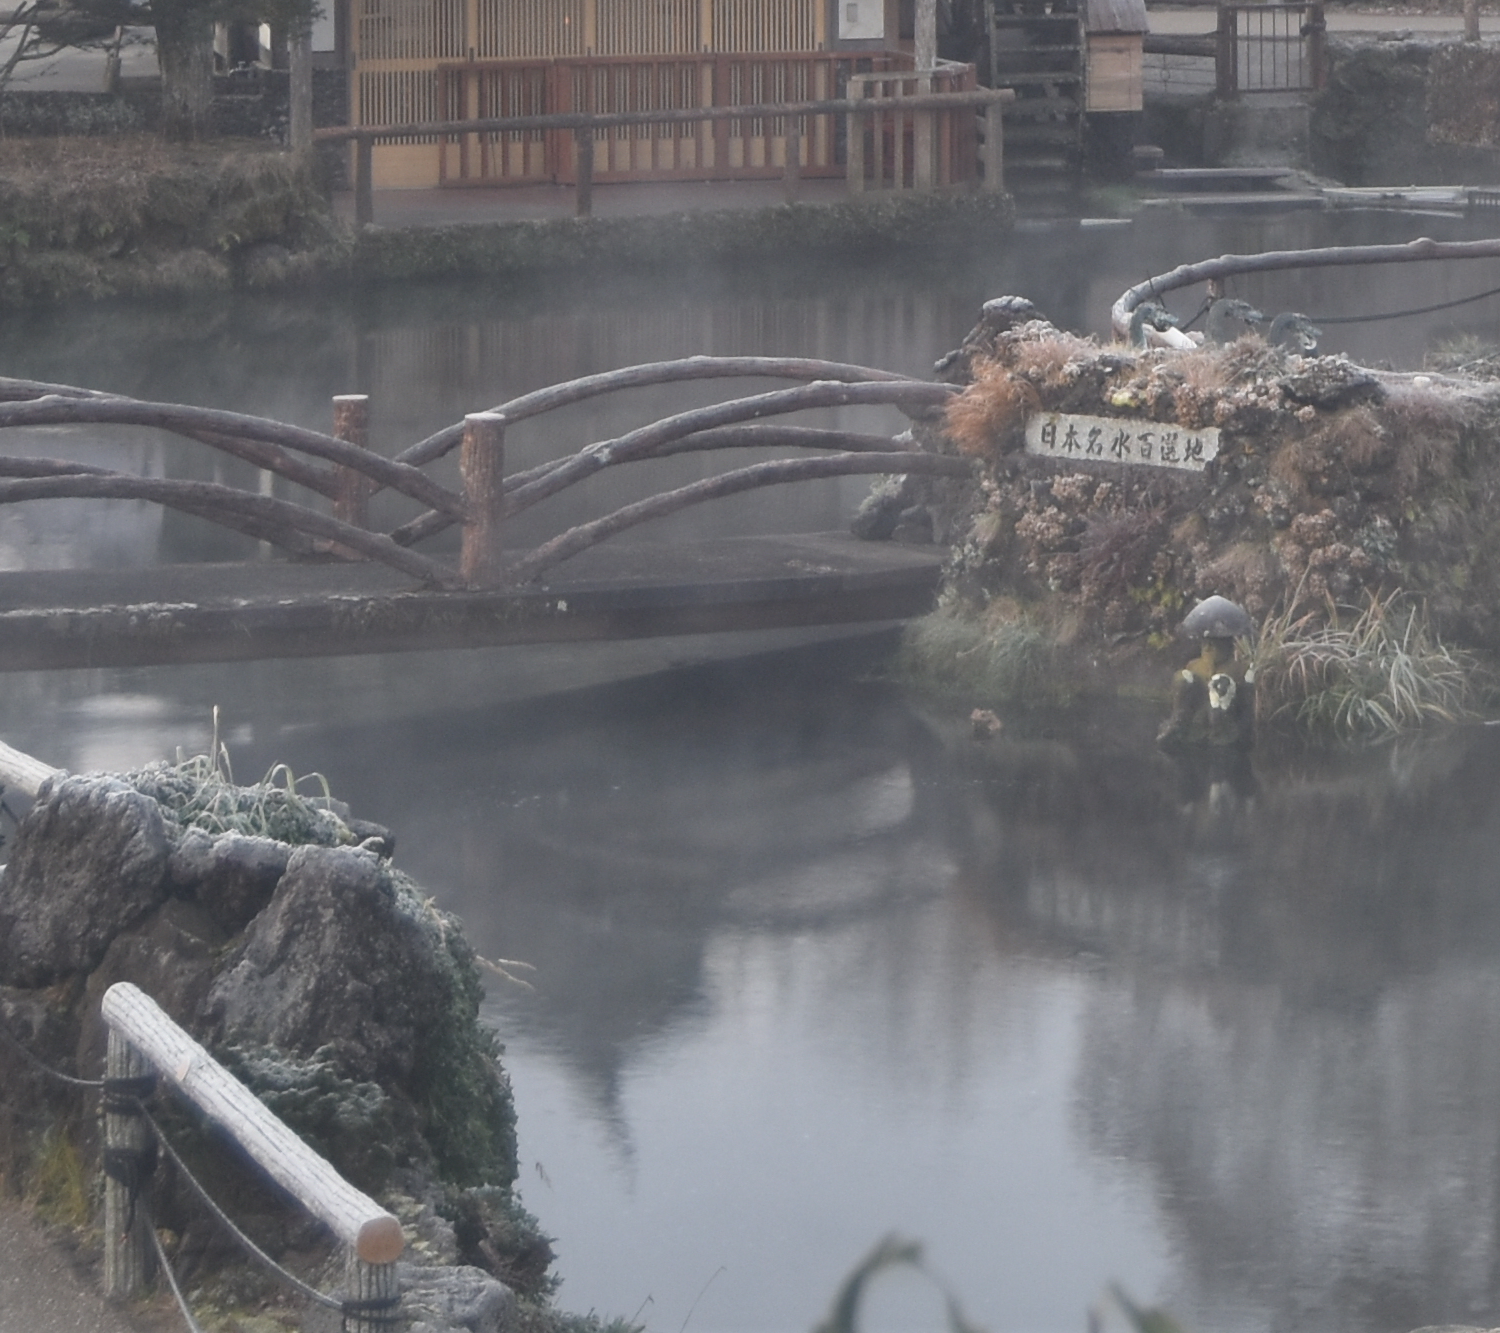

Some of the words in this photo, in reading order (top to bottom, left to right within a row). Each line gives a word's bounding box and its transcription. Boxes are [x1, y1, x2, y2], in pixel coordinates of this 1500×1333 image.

[1041, 422, 1206, 464] 日本名水百選地
